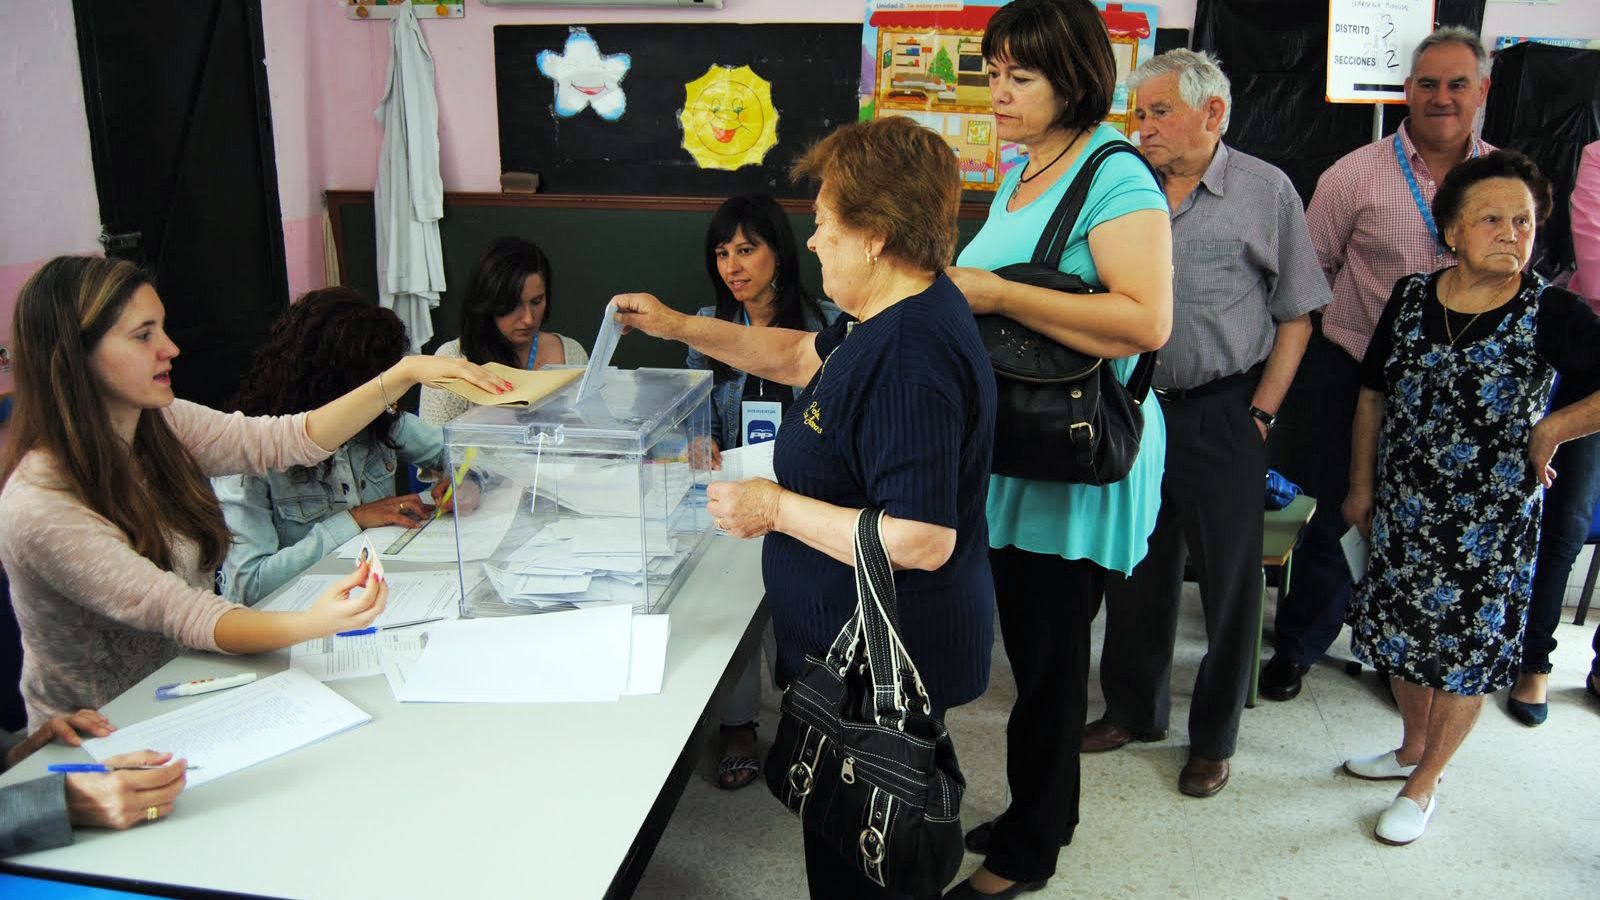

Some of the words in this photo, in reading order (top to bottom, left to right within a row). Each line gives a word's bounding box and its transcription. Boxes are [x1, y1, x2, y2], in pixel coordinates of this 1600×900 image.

[1335, 23, 1370, 35] DISTRITO
[1334, 55, 1376, 67] SECCIONES
[1385, 49, 1399, 68] 2
